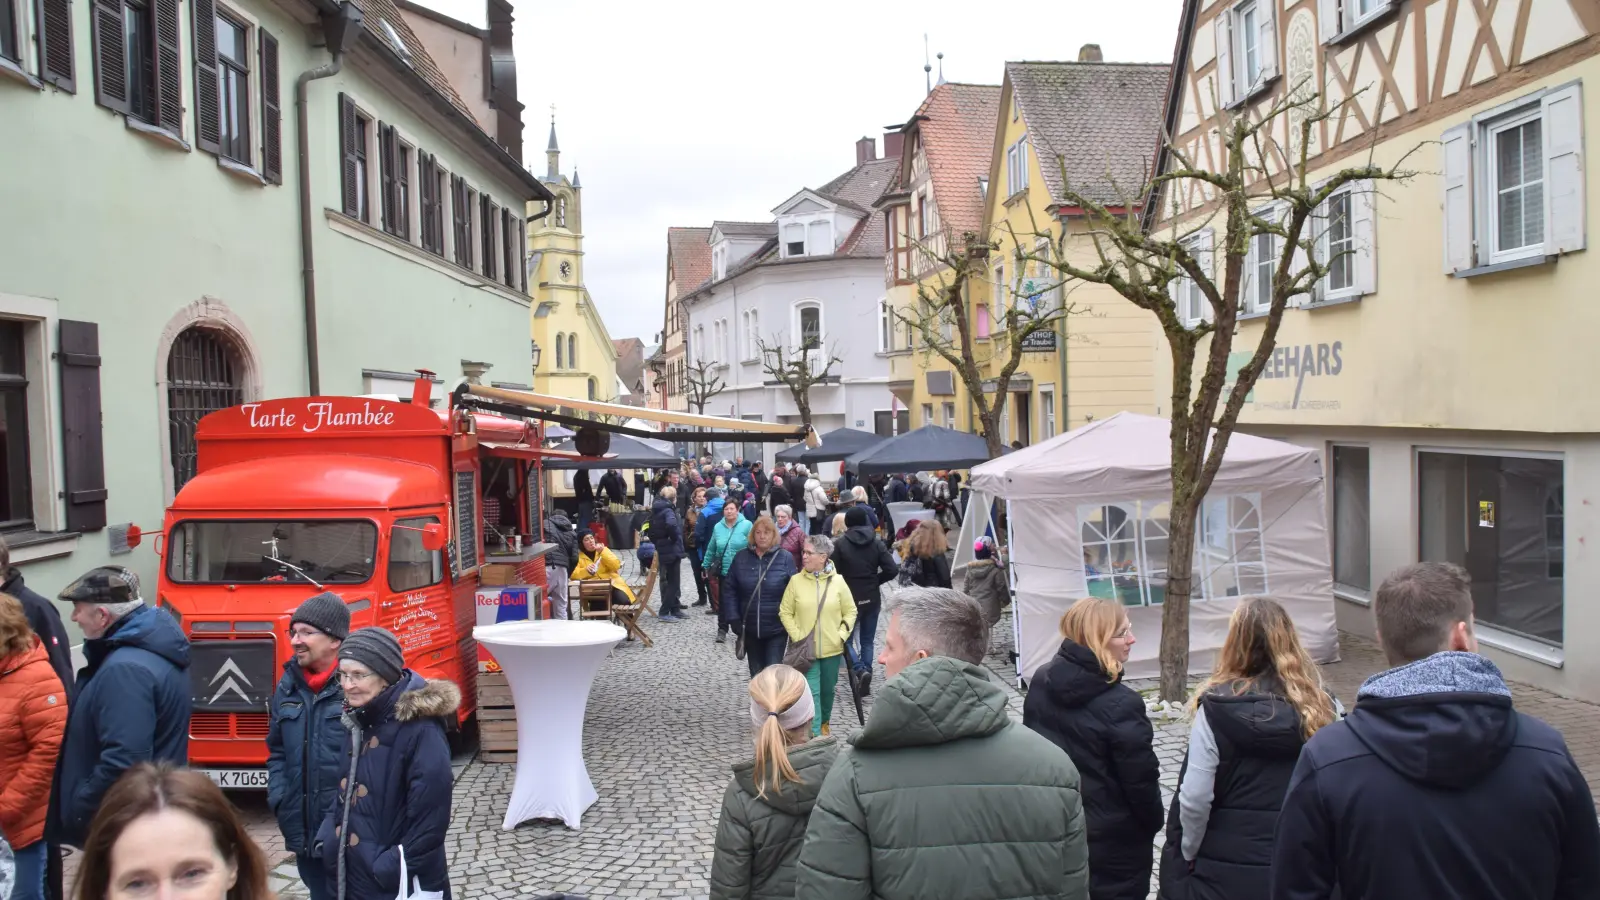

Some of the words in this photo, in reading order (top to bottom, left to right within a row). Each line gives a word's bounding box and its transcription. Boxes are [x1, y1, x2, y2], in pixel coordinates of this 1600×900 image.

[241, 403, 296, 427] Tarte
[302, 401, 395, 432] Flambée
[477, 594, 501, 606] Red
[502, 593, 526, 606] Bull
[417, 605, 438, 620] Service
[220, 772, 228, 785] K
[232, 772, 268, 785] 7065
